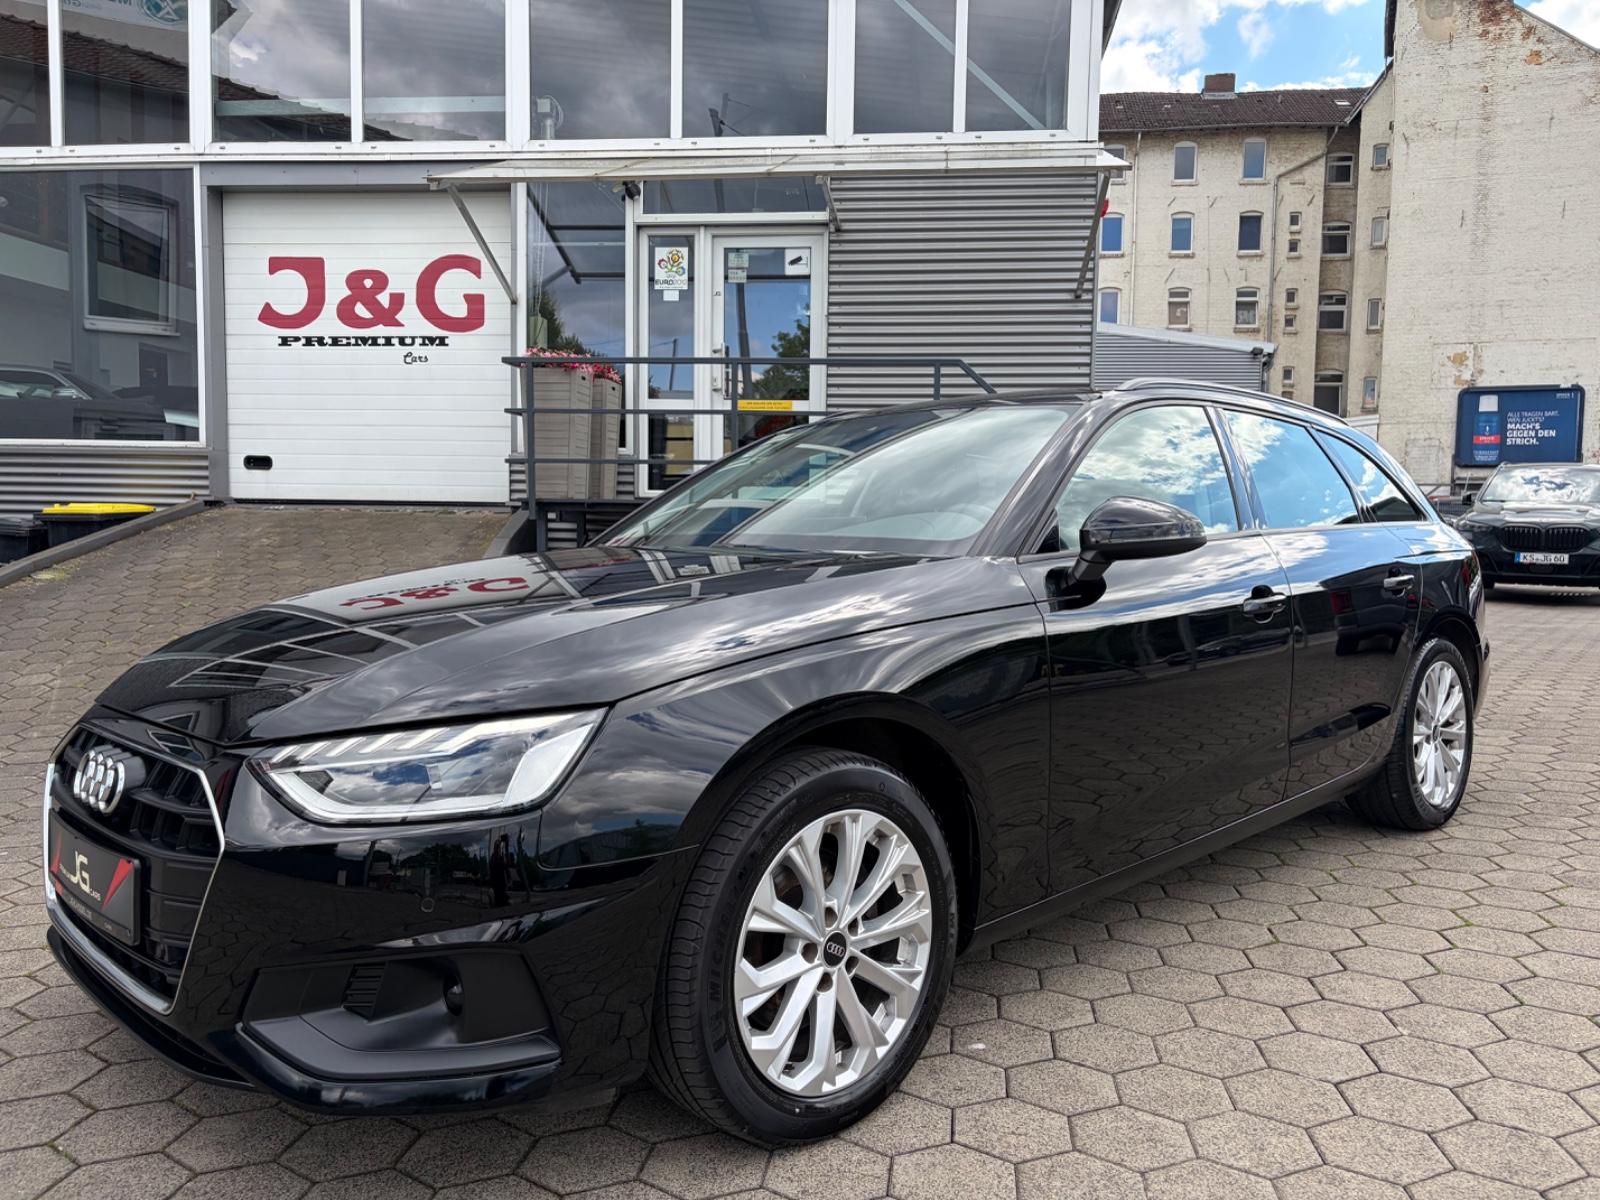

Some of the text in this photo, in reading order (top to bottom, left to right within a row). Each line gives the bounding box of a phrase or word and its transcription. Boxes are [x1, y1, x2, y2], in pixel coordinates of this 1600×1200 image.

[257, 254, 485, 333] J&G
[278, 335, 449, 347] PREMIUM
[403, 352, 429, 365] Cars
